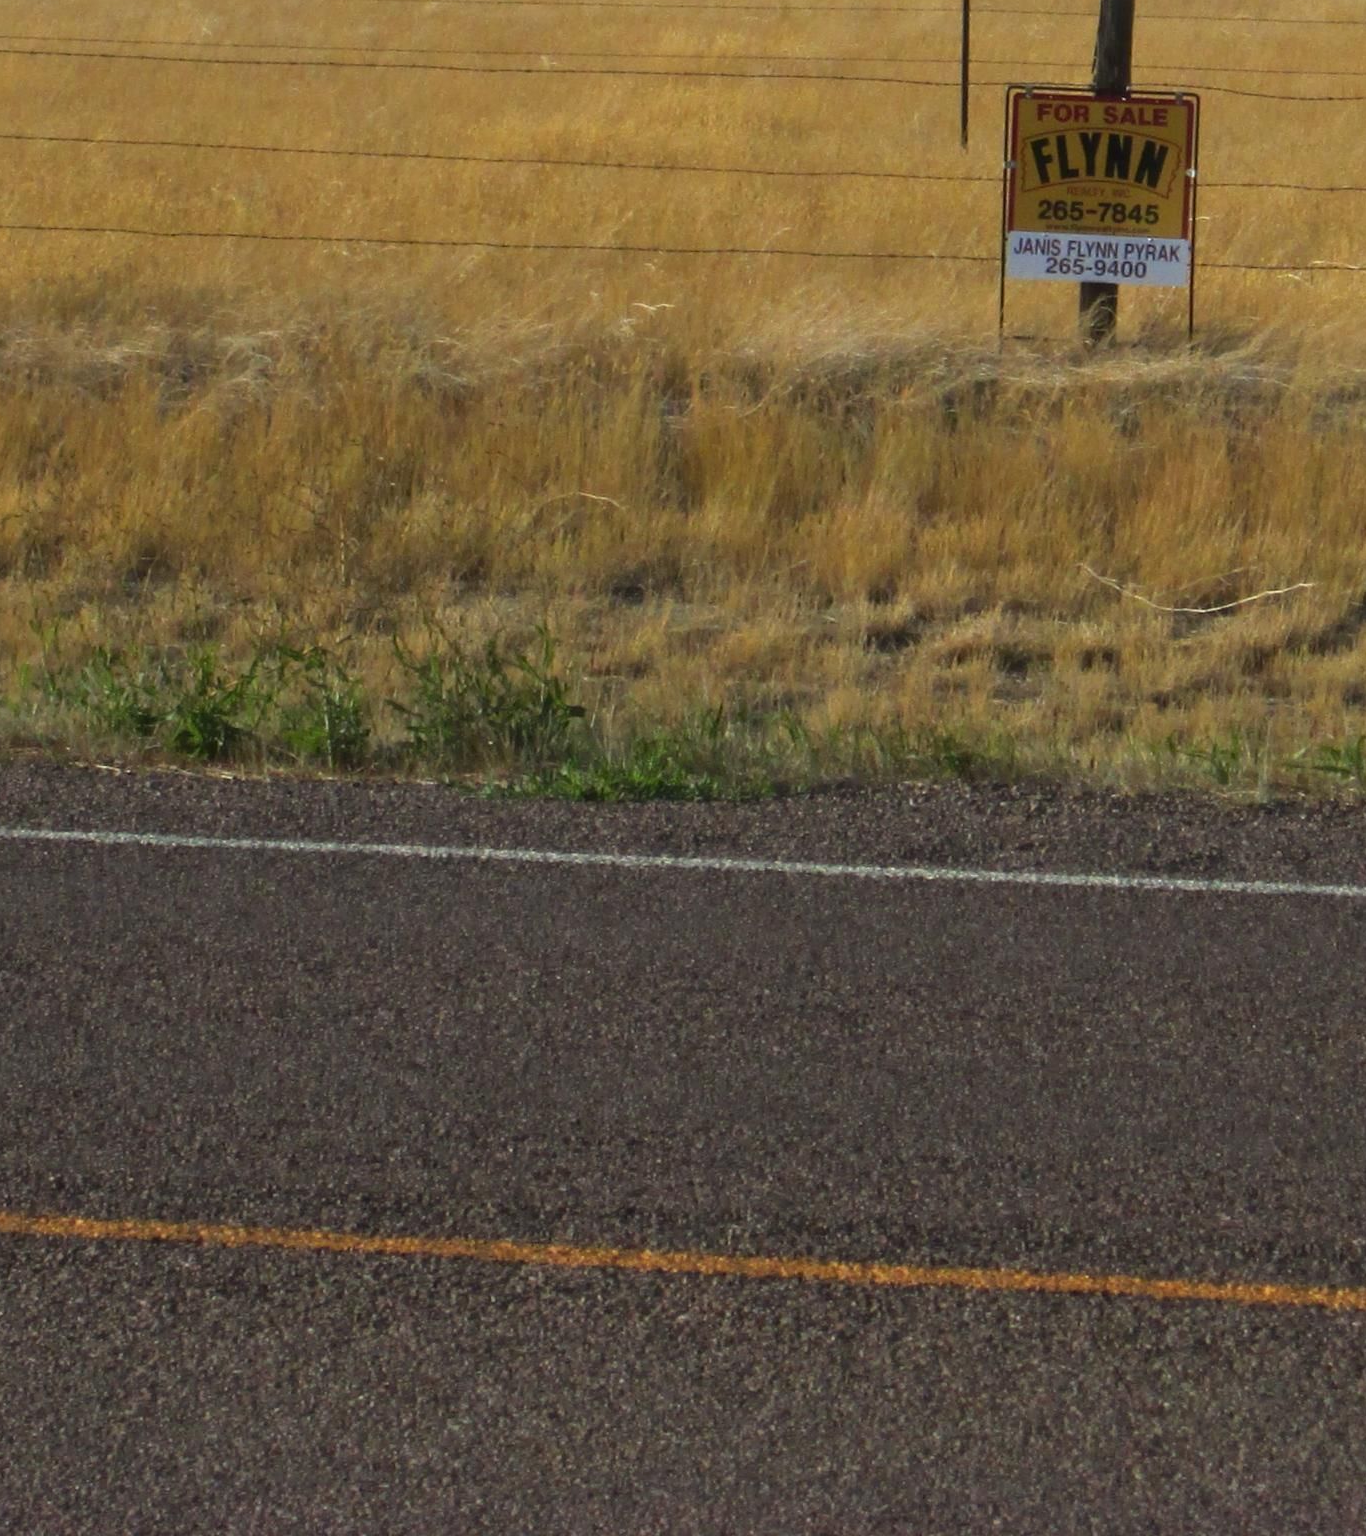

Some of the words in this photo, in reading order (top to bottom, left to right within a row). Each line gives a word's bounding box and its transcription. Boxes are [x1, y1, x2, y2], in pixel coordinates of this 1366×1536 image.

[1037, 104, 1089, 123] FOR
[1103, 106, 1168, 127] SALE
[1030, 132, 1168, 189] FLYNN
[1038, 200, 1159, 224] 265-7845
[1013, 237, 1061, 256] JANIS
[1067, 240, 1119, 259] FLYNN
[1124, 243, 1181, 262] PYRAK
[1046, 258, 1147, 278] 265-9400
